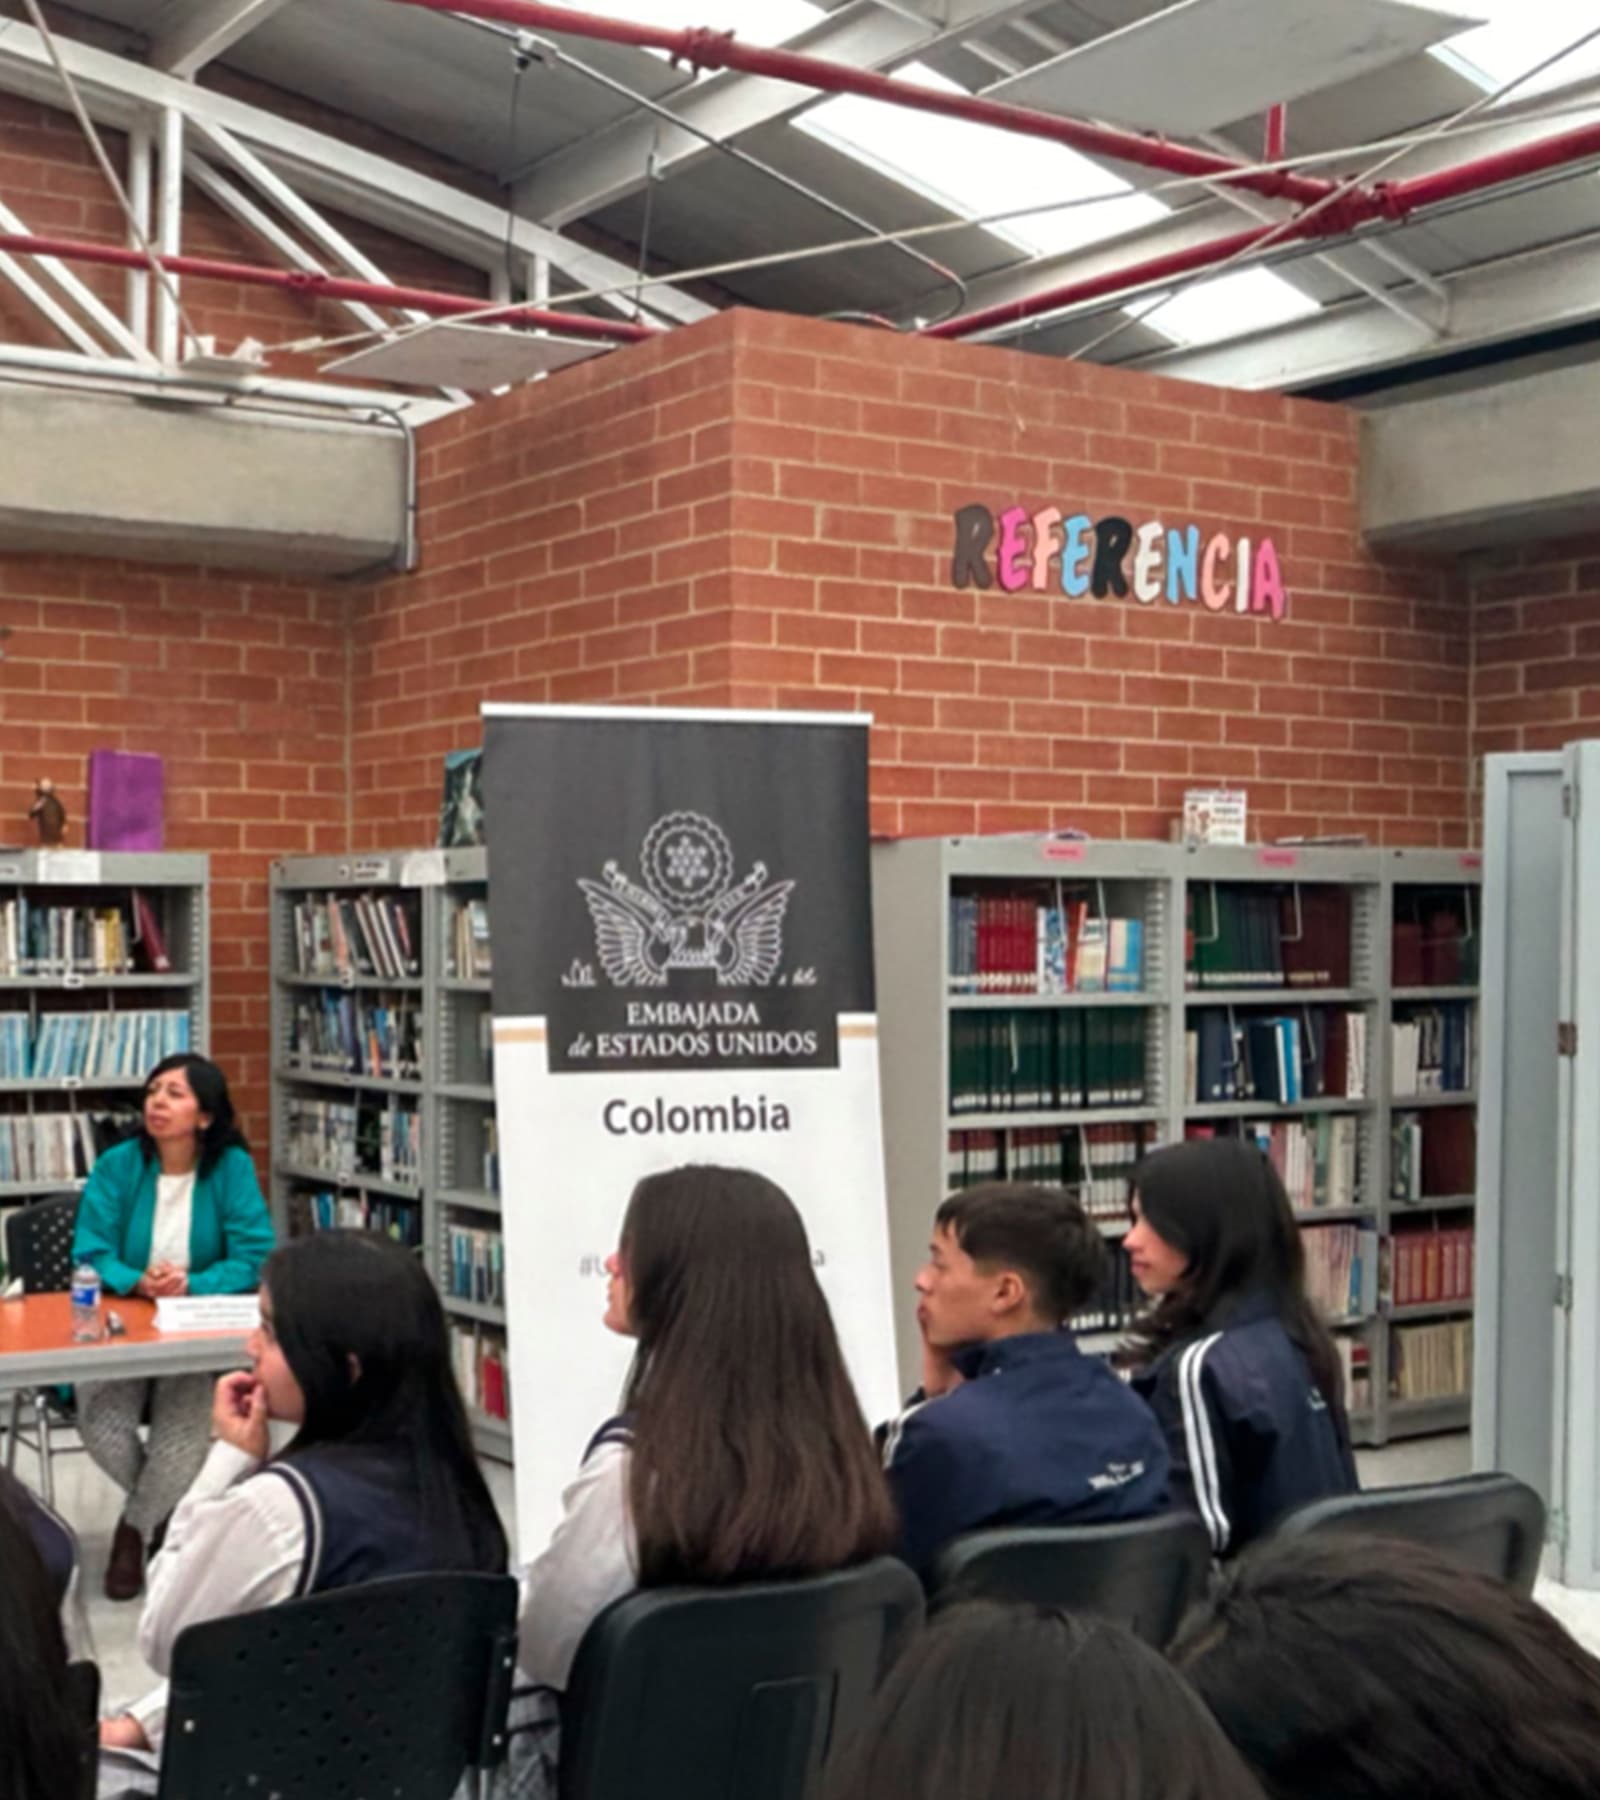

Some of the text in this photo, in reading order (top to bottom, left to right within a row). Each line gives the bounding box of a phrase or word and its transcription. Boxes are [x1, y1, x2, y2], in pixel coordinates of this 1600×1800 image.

[952, 503, 1287, 620] REFERENCIA
[626, 1002, 761, 1029] EMBAJADA
[568, 1031, 818, 1057] de ESTADOS UNIDOS
[602, 1095, 791, 1136] Colombia
